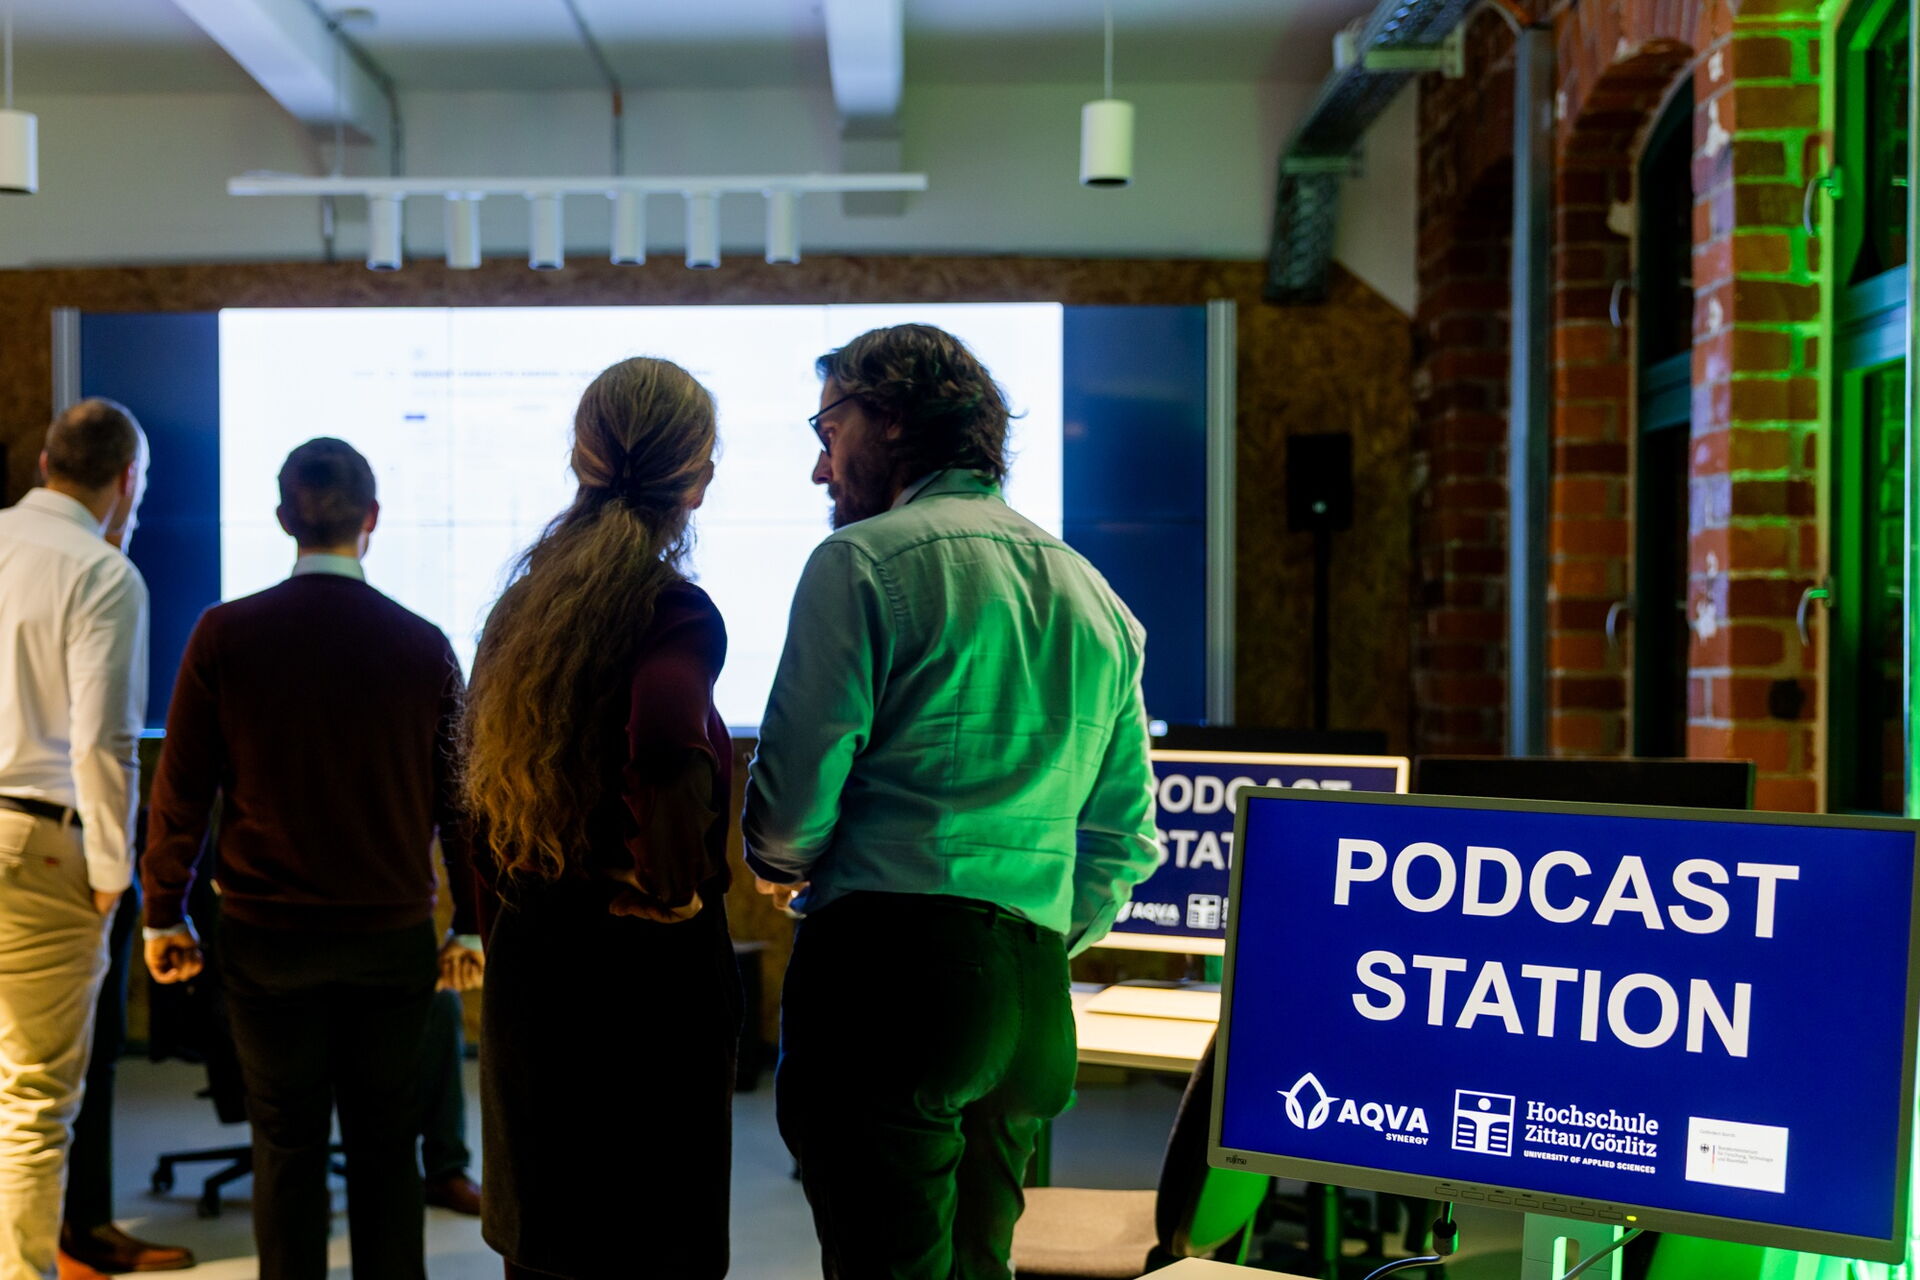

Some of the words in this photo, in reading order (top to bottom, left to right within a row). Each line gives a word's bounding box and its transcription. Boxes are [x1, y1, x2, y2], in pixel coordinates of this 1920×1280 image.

[1334, 838, 1799, 938] PODCAST
[1353, 951, 1751, 1057] STATION
[1336, 1099, 1429, 1134] AQVA
[1526, 1100, 1659, 1136] Hochschule
[1385, 1132, 1429, 1146] SYNERGY
[1524, 1124, 1657, 1158] Zittau/Görlitz
[1523, 1149, 1569, 1163] UNIVERSITY
[1569, 1156, 1581, 1164] OF
[1581, 1157, 1616, 1169] APPLIED
[1616, 1161, 1656, 1175] SCIENCES
